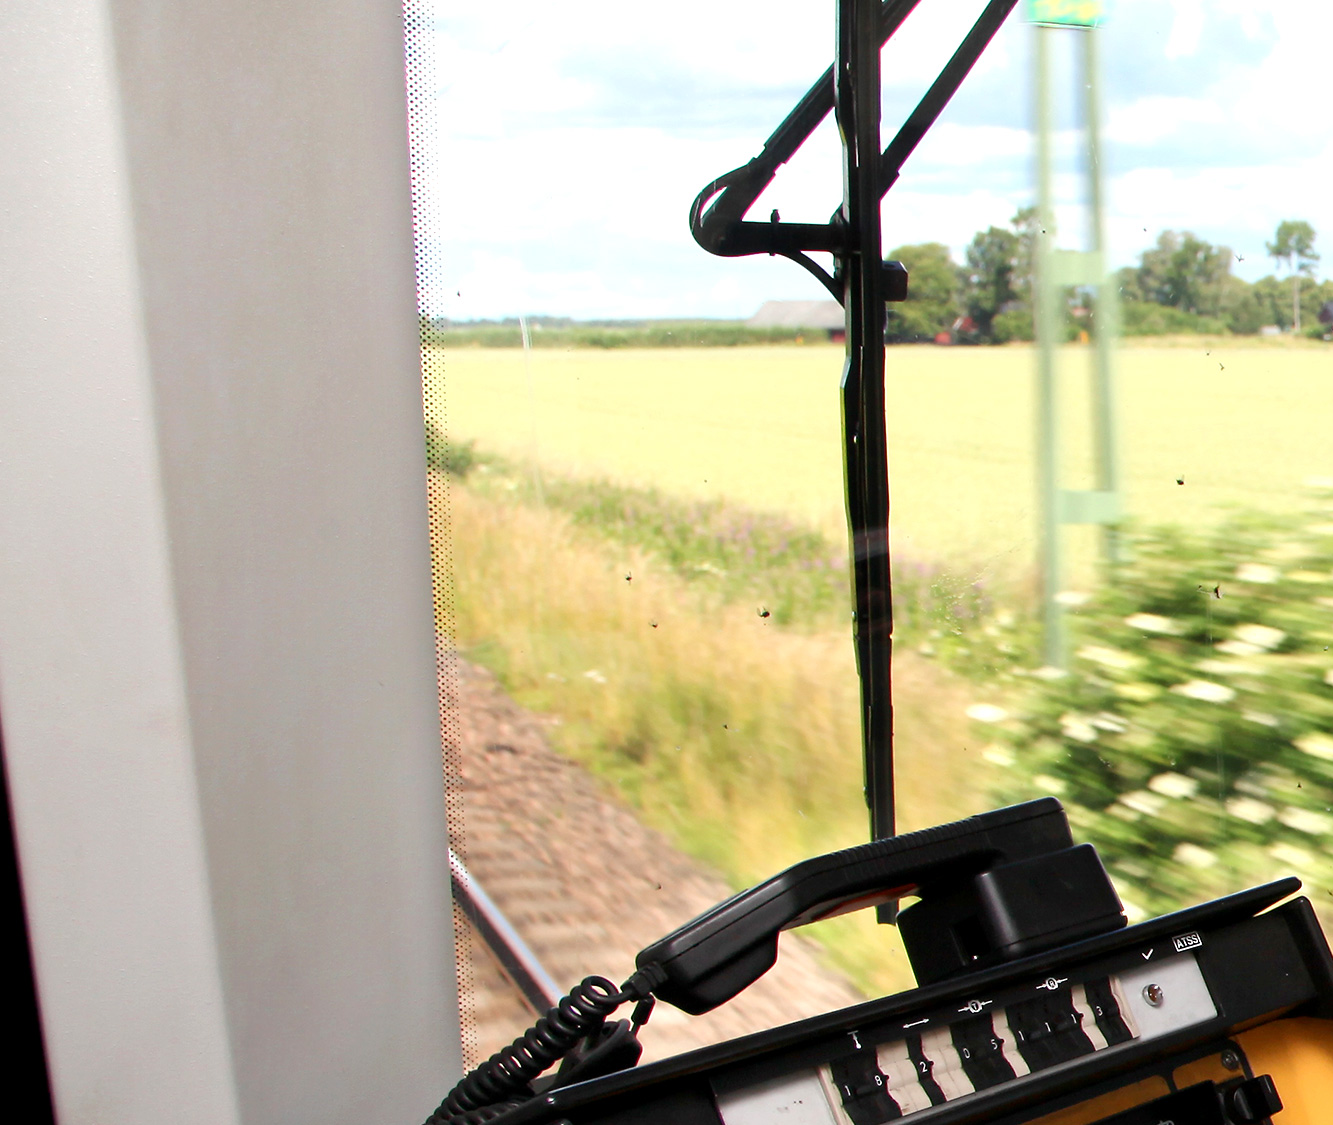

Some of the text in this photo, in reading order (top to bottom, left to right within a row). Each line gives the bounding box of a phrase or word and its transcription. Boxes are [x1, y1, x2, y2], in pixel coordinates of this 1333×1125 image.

[1177, 934, 1199, 949] ATSS
[1096, 1006, 1103, 1016] 3
[963, 1039, 998, 1059] 0 5
[920, 1061, 928, 1073] 2
[874, 1075, 882, 1086] 8
